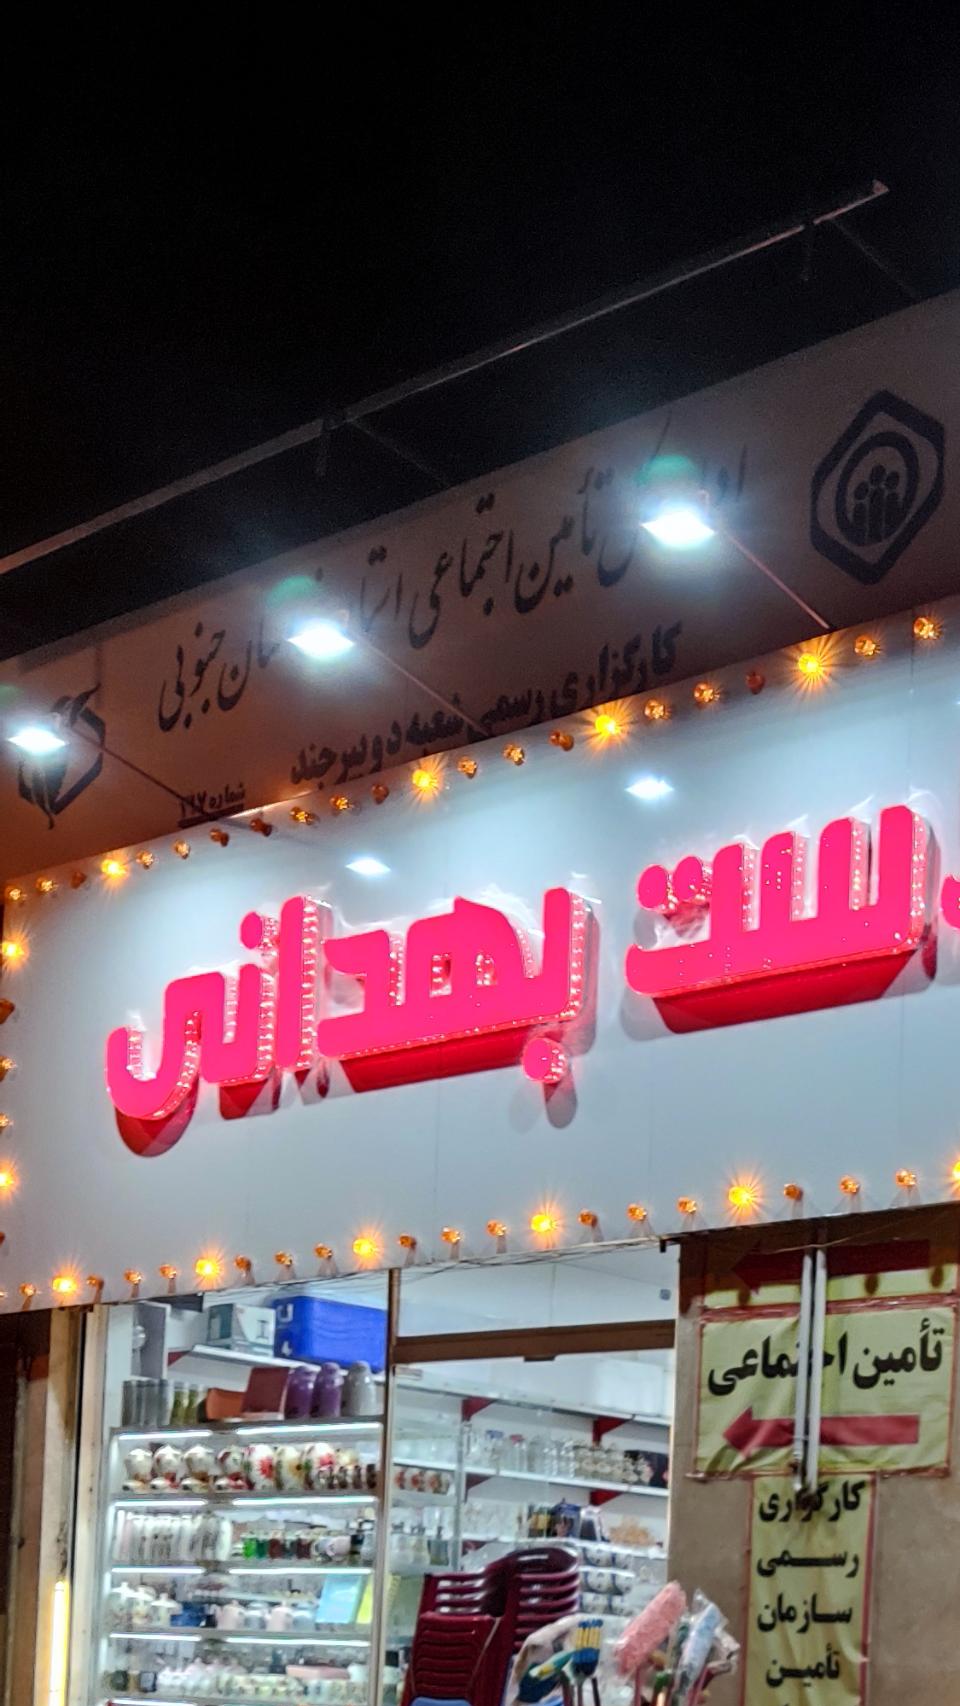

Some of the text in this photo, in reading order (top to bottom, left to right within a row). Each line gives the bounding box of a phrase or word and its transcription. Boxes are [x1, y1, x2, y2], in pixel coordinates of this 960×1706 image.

[407, 492, 514, 650] اجتماعی
[512, 465, 614, 614] تأمین
[158, 621, 226, 733] جنوبی
[549, 621, 682, 712] کارگزاری
[105, 886, 587, 1121] بهدانی
[853, 1317, 945, 1390] تأمین
[757, 1549, 860, 1578] رسمی
[756, 1592, 853, 1634] سازمان
[765, 1646, 841, 1687] تأمین
